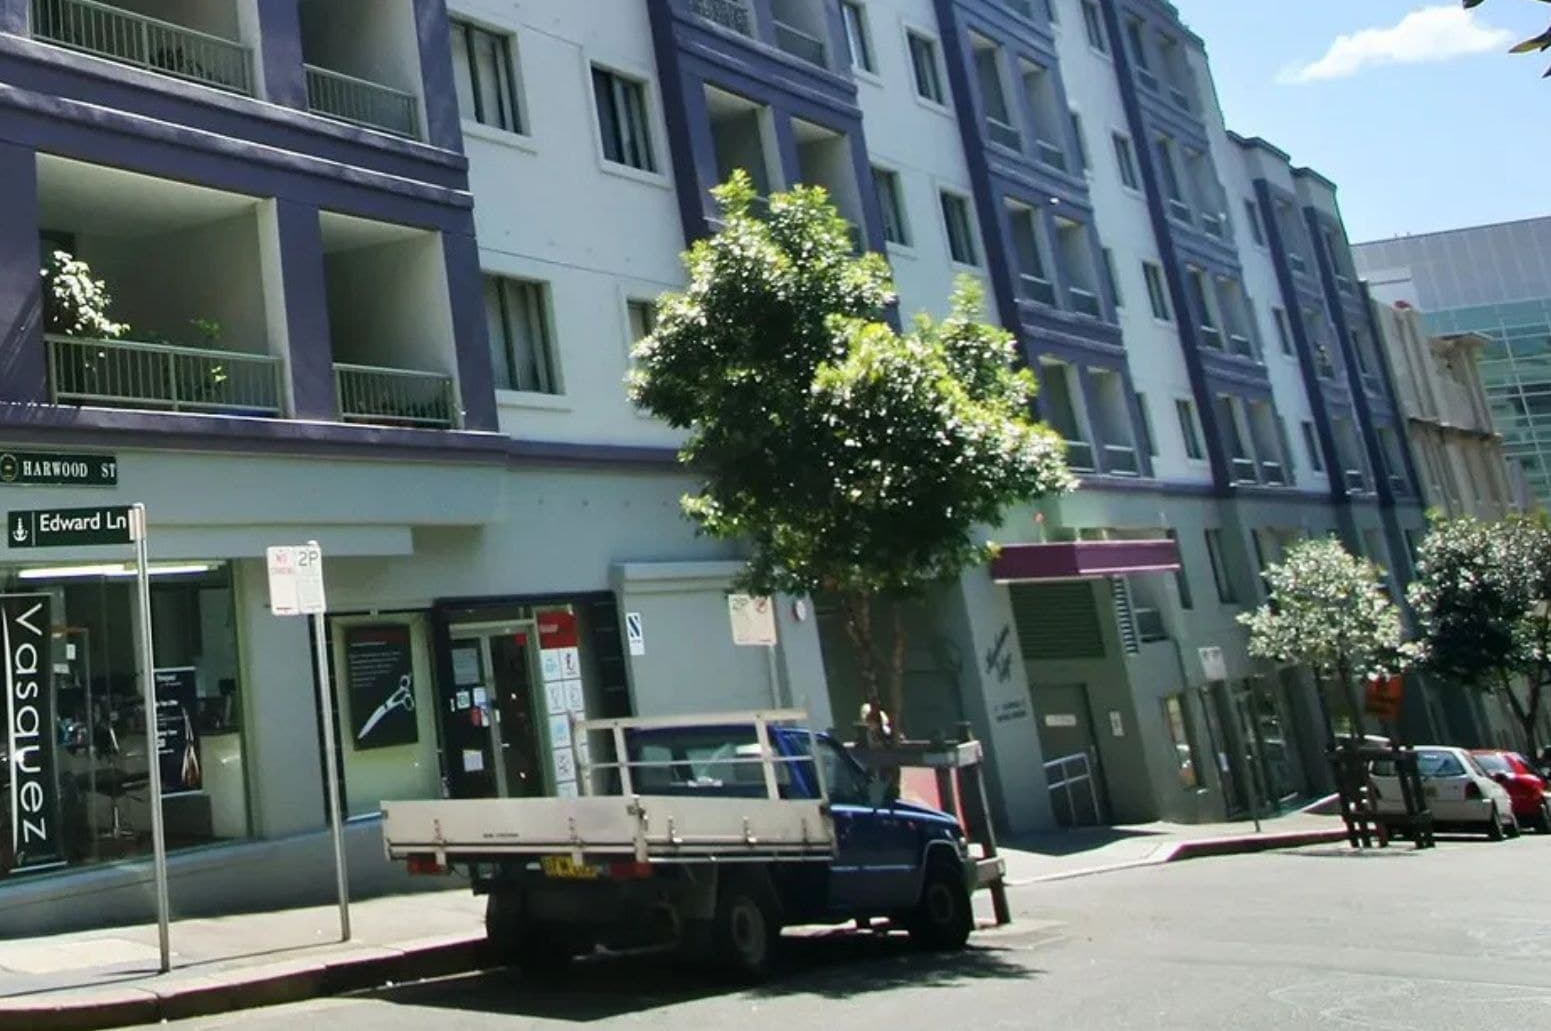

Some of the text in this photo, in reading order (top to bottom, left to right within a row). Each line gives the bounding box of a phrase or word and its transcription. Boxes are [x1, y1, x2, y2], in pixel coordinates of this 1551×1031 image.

[23, 461, 116, 478] HARWOOD ST
[39, 511, 127, 531] Edward Ln
[298, 550, 319, 568] 2P
[13, 602, 47, 843] Vasquez
